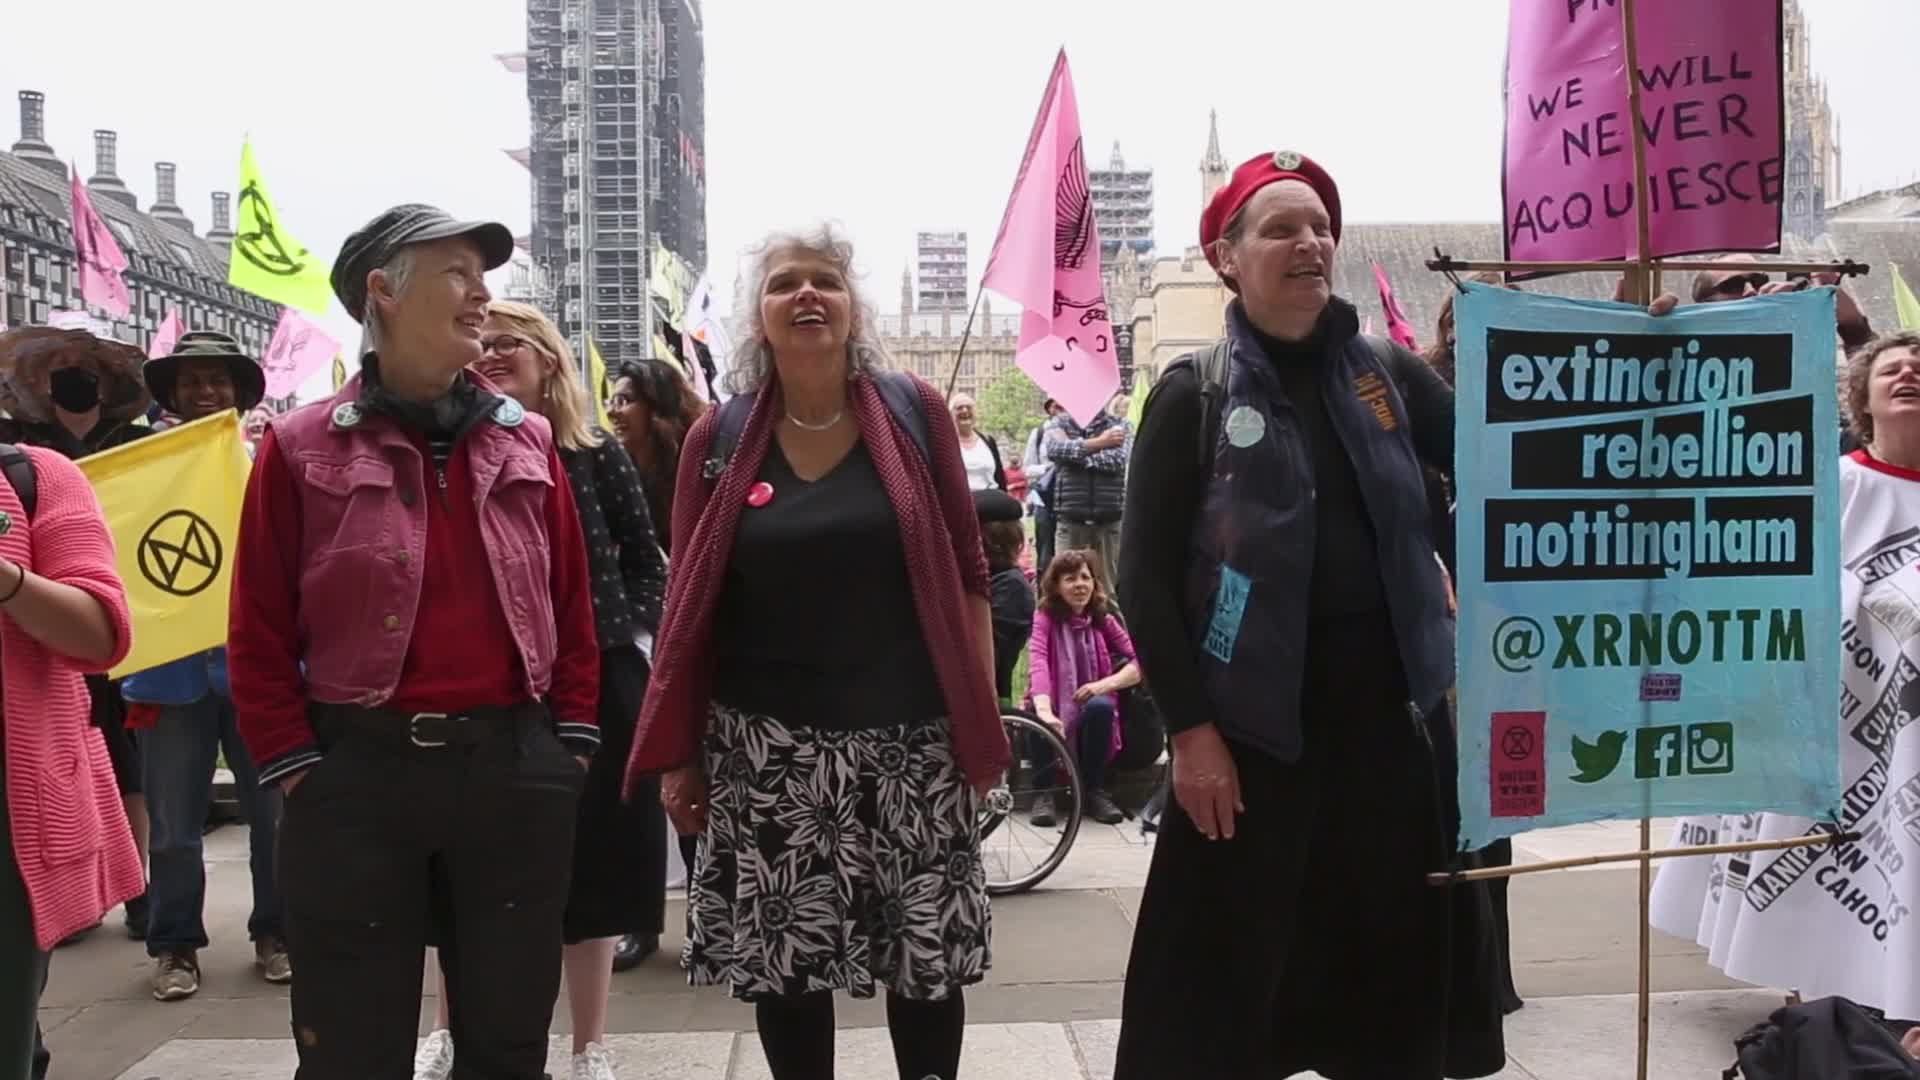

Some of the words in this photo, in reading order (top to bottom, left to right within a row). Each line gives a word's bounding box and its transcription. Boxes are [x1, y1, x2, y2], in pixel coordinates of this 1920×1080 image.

[1527, 77, 1584, 121] WE
[1637, 52, 1753, 92] WILL
[1562, 94, 1754, 166] NEVER
[1510, 157, 1780, 245] ACQUIESCE
[1501, 339, 1754, 402] extinction
[1582, 404, 1803, 480] rebellion
[1503, 502, 1797, 578] nottingham
[1492, 608, 1806, 673] @XRNOTTM
[1861, 658, 1919, 746] CULTURE
[1748, 764, 1888, 912] MANIPUATION
[1814, 864, 1889, 943] CAHOO
